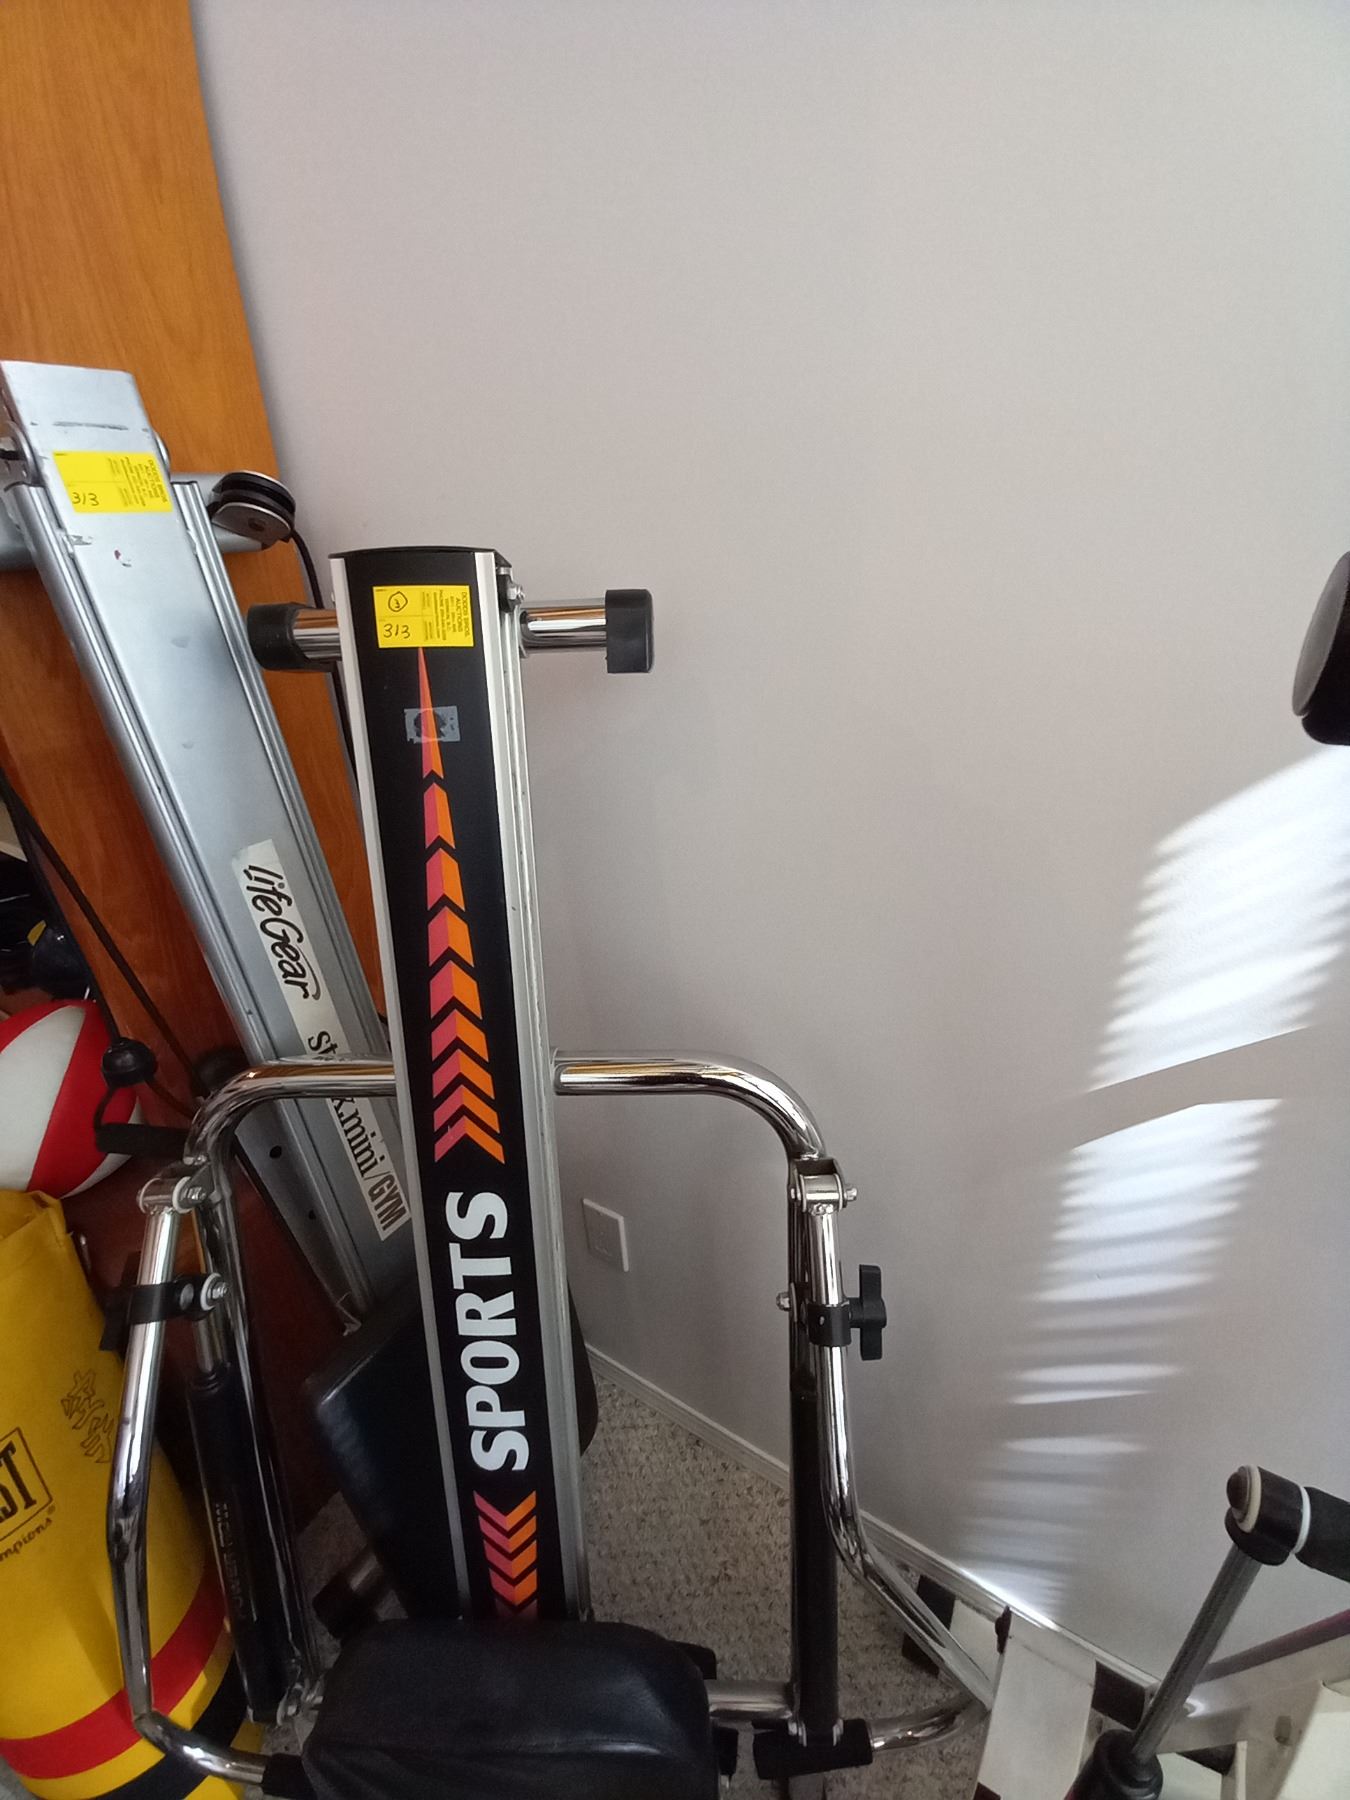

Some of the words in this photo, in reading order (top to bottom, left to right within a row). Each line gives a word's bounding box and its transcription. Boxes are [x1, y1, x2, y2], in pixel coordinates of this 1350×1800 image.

[71, 491, 100, 507] 313
[383, 623, 411, 639] 313
[445, 1191, 530, 1472] SPORTS
